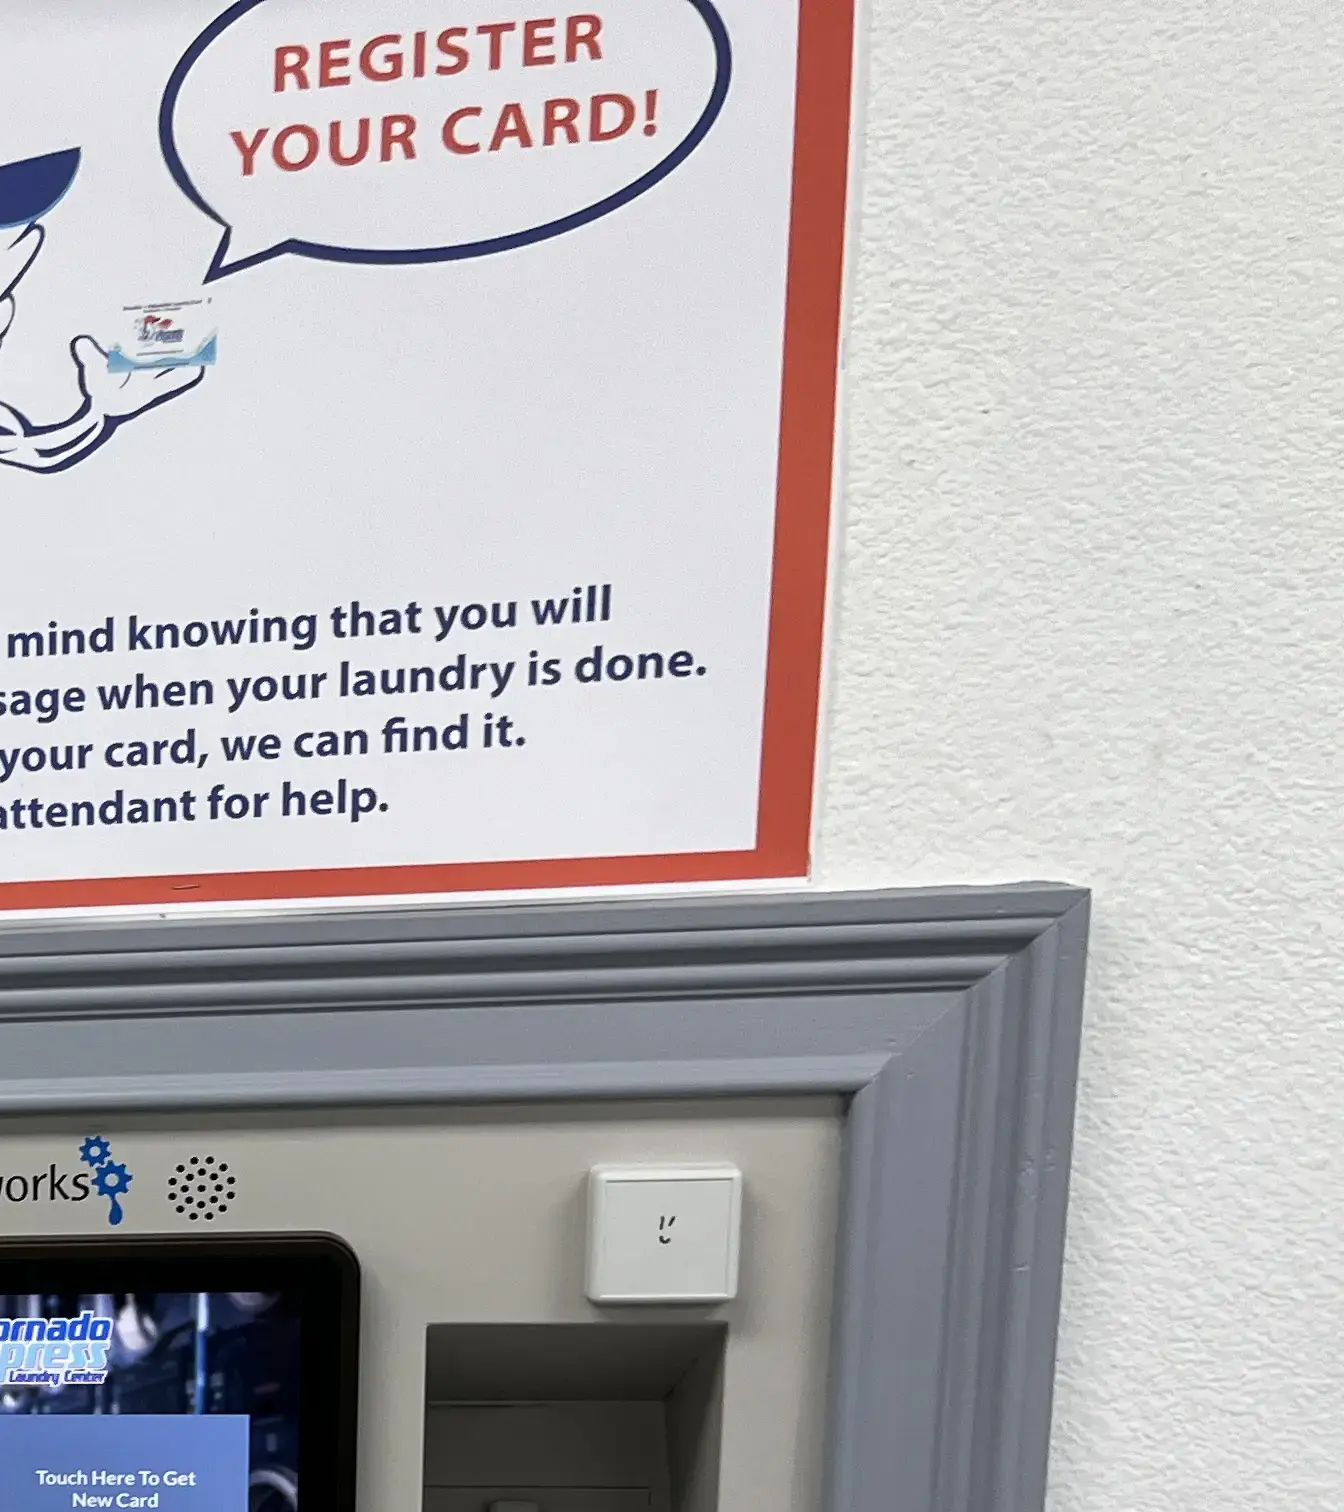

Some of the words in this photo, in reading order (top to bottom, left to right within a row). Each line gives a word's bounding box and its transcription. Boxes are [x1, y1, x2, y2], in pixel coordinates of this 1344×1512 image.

[273, 13, 603, 94] REGISTER
[229, 113, 417, 177] YOUR
[440, 87, 659, 156] CARD!
[6, 615, 115, 660] mind
[127, 606, 318, 652] knowing
[328, 599, 424, 640] that
[432, 600, 518, 644] you
[530, 582, 613, 627] will
[96, 671, 215, 712] when
[225, 671, 329, 715] your
[338, 652, 517, 700] laundry
[526, 649, 563, 687] is
[573, 644, 708, 685] done.
[103, 727, 210, 770] card,
[219, 733, 283, 763] we
[292, 728, 370, 759] can
[380, 712, 470, 755] find
[482, 711, 527, 749] it.
[205, 782, 271, 821] for
[280, 777, 390, 824] help.
[9, 1370, 60, 1386] Laundry
[64, 1370, 104, 1383] Center
[35, 1470, 88, 1486] Touch
[92, 1470, 135, 1486] Here
[138, 1471, 160, 1486] To
[163, 1471, 197, 1486] Get
[72, 1493, 113, 1507] New
[116, 1493, 158, 1508] Card
